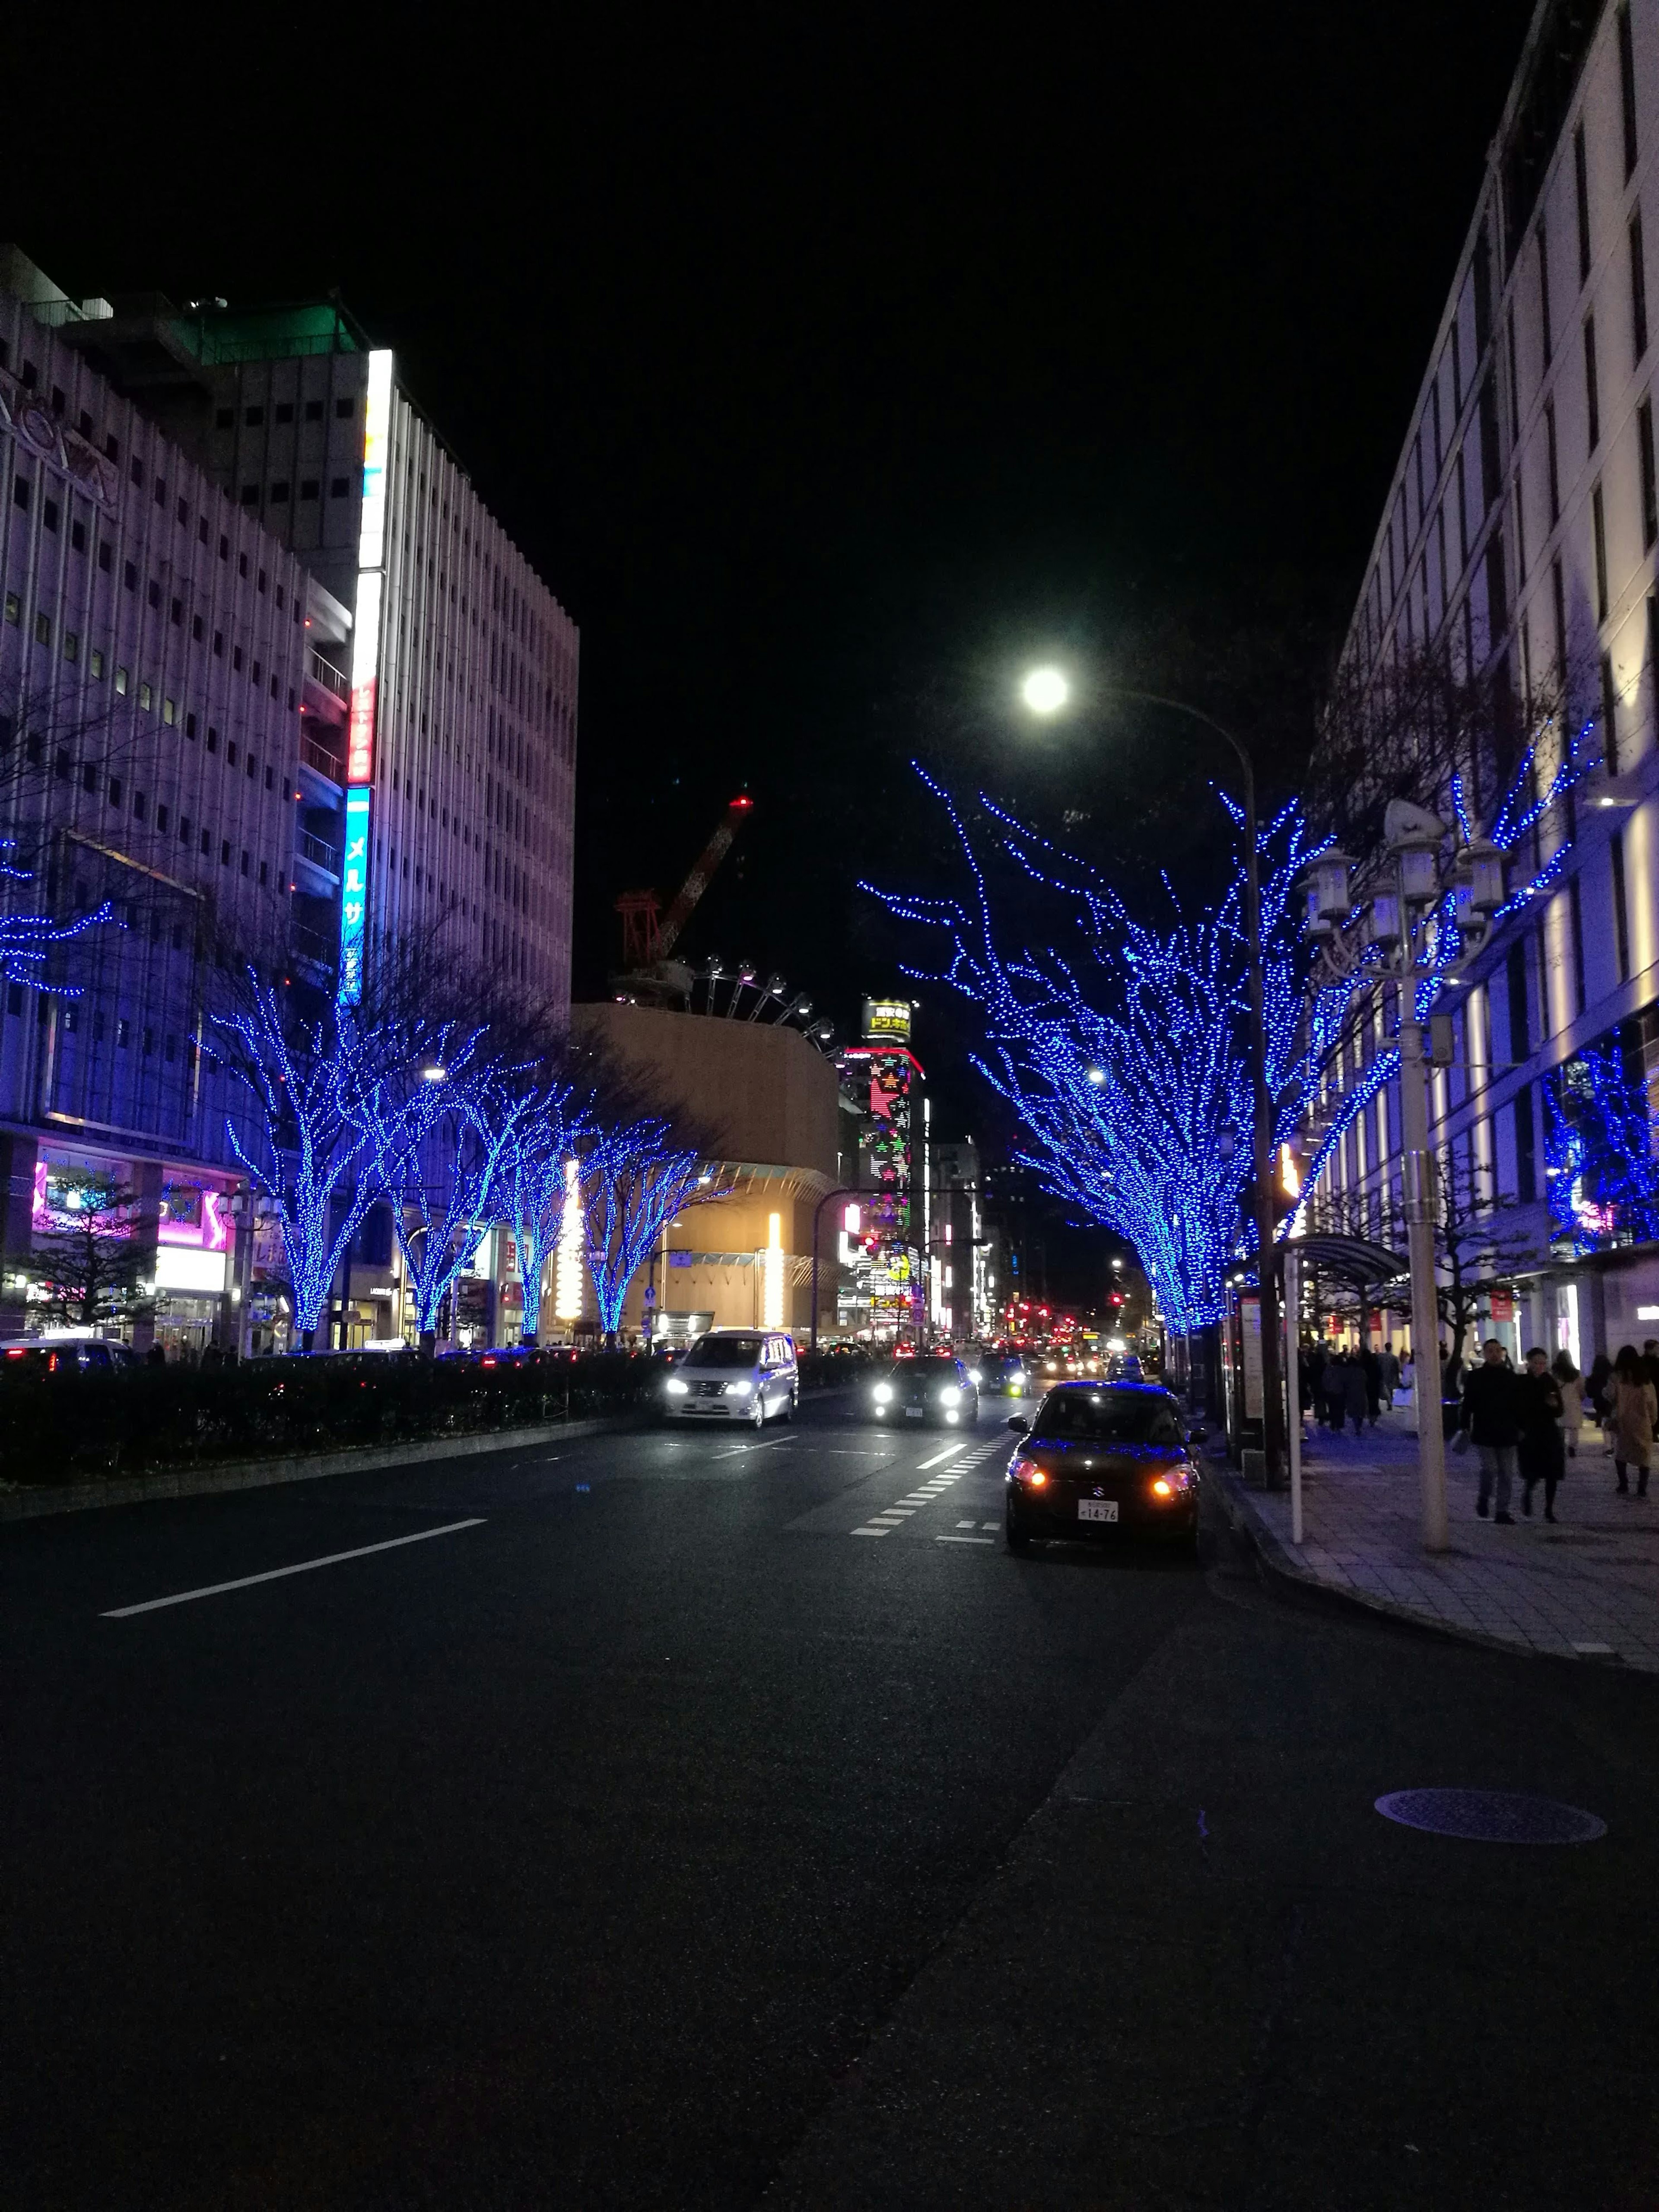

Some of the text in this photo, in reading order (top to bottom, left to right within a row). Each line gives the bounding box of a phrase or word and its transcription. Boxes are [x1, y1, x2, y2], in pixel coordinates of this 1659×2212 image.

[344, 836, 365, 925] メルサ
[1089, 1509, 1116, 1520] 14-76
